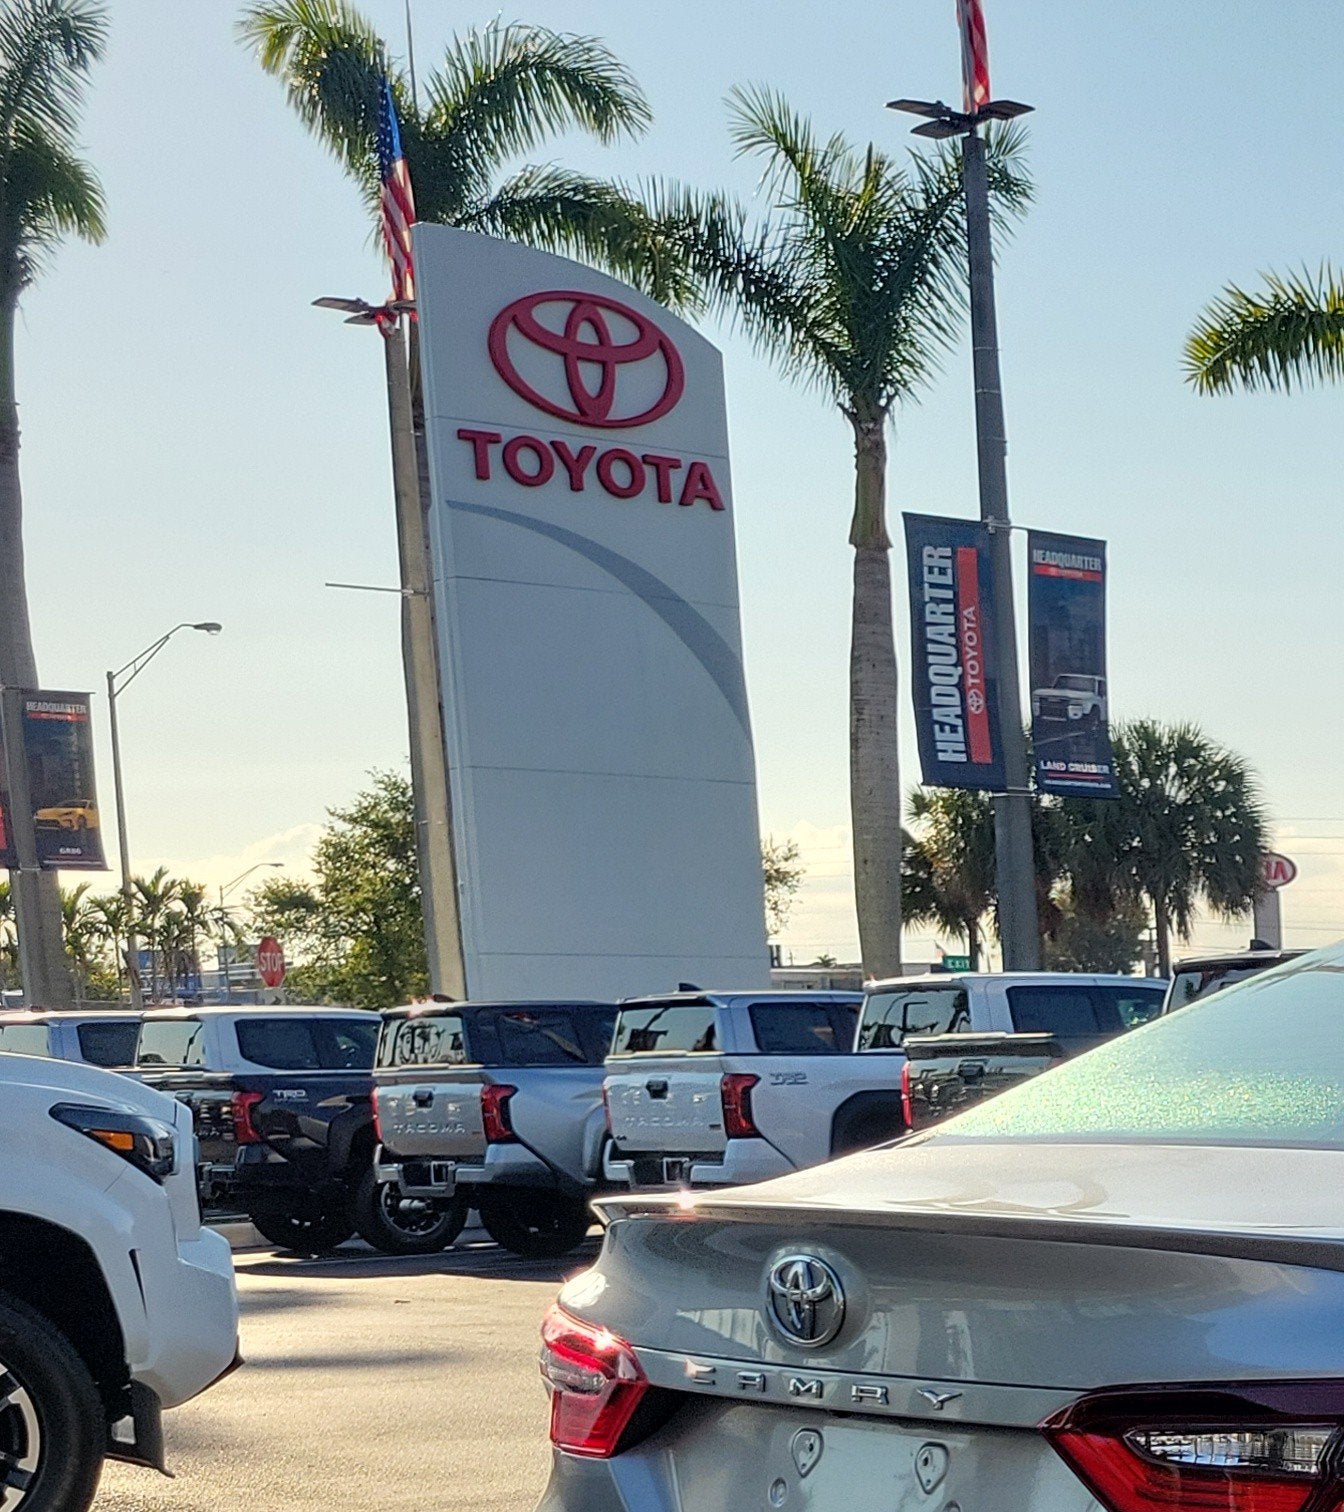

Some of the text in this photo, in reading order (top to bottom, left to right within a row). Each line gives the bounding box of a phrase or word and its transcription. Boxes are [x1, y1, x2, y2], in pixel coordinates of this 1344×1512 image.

[457, 428, 725, 511] TOYOTA
[1033, 549, 1102, 571] HEADQUARTER
[922, 545, 968, 763] HEADQUARTER
[961, 606, 981, 688] TOYOTA
[1040, 760, 1067, 771] LAND
[259, 952, 283, 972] STOP
[272, 1089, 306, 1098] TRD
[684, 1358, 963, 1411] CAMRY
